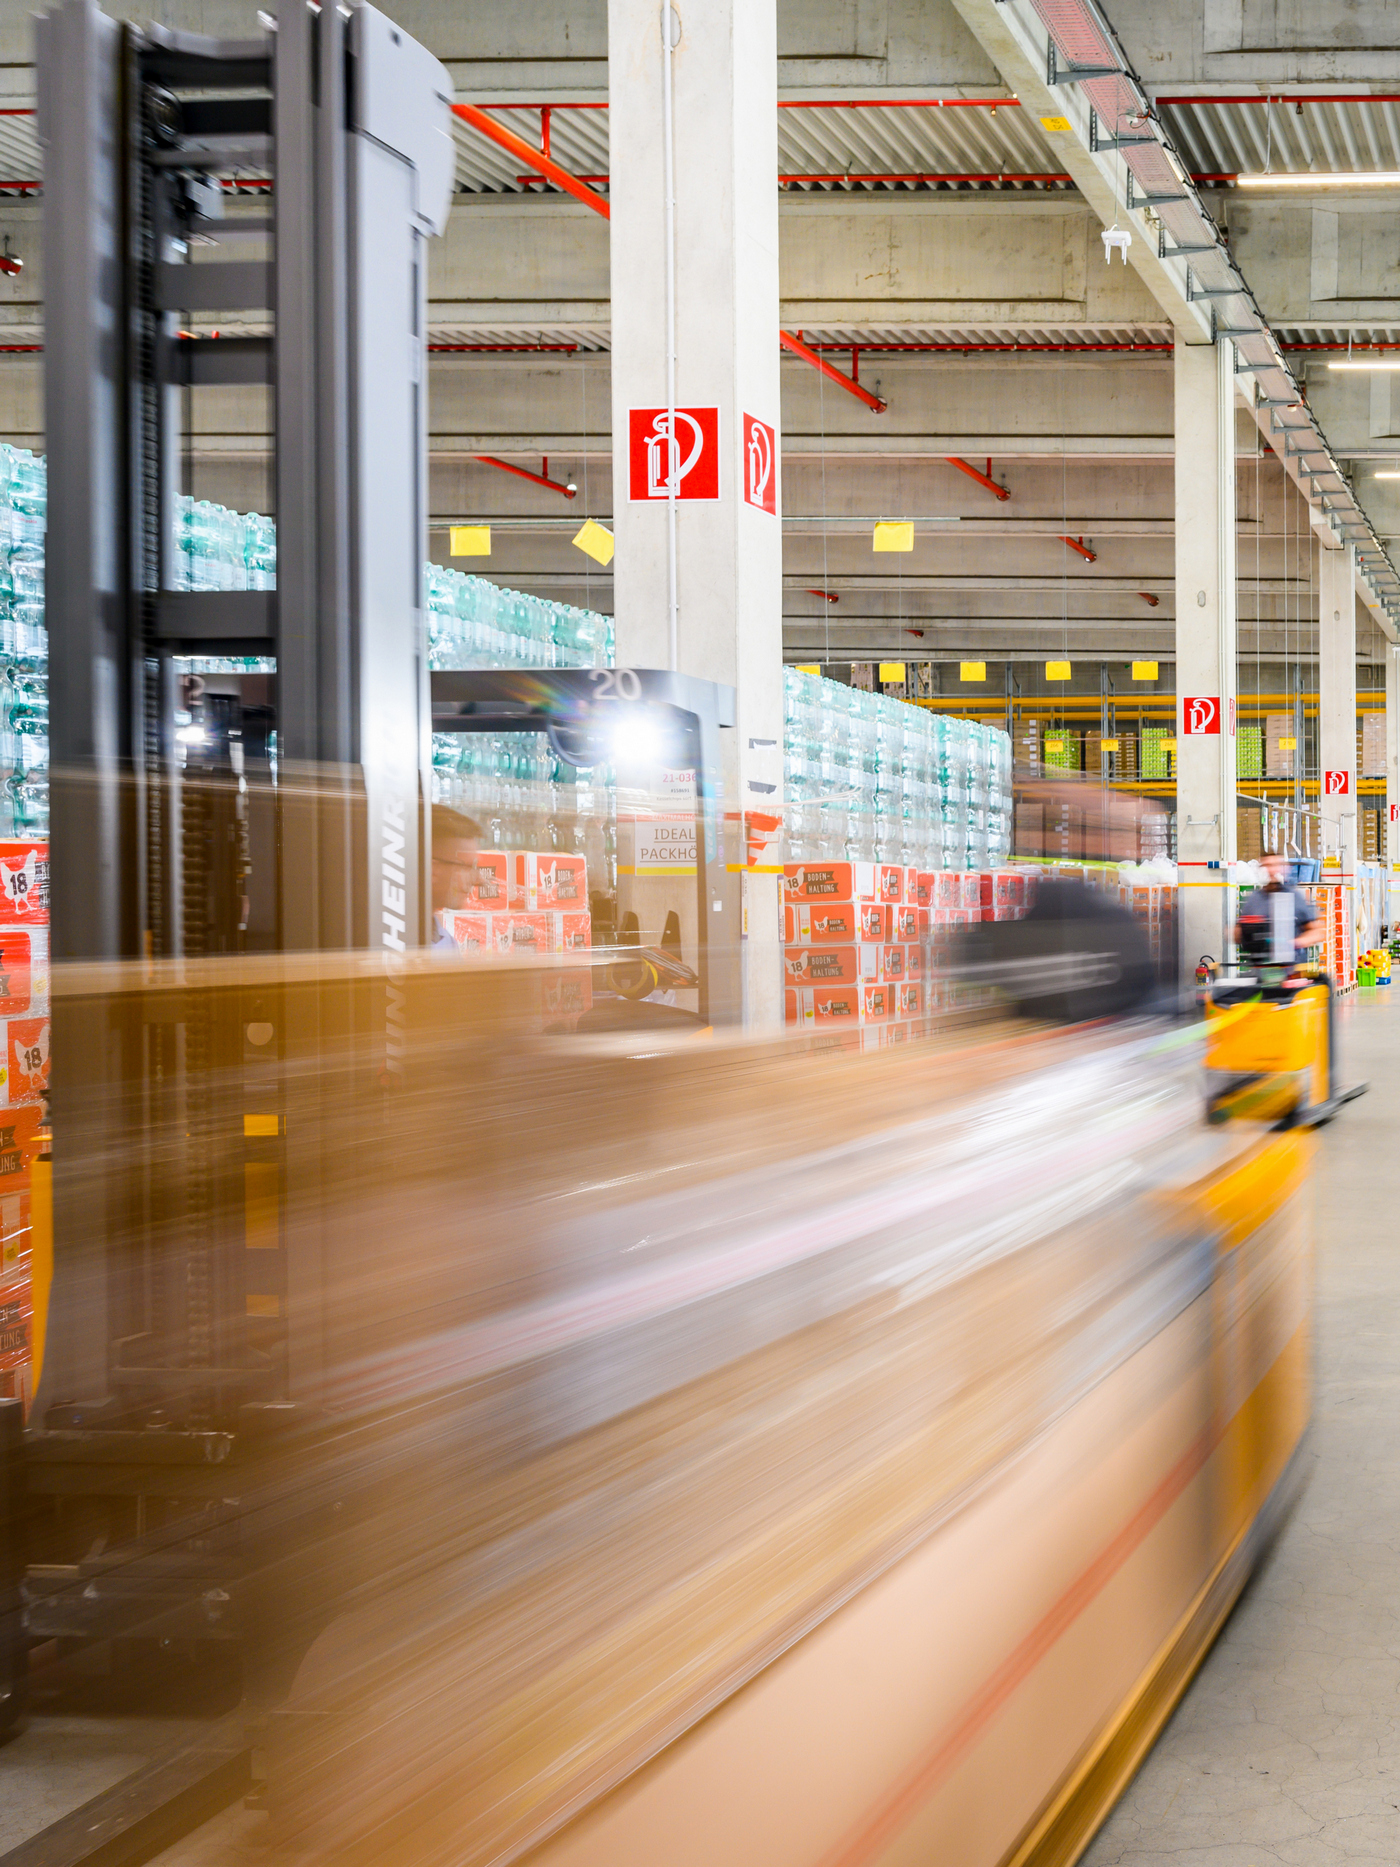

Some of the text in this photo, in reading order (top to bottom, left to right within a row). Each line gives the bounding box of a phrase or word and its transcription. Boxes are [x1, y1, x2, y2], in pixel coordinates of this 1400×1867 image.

[588, 668, 642, 700] 20
[808, 873, 830, 881] BODEN-
[10, 873, 28, 895] 18
[787, 878, 799, 889] 18
[809, 884, 834, 893] HALTUNG
[812, 957, 834, 965] BODEN-
[791, 962, 803, 972] 18
[813, 968, 839, 976] HALTUNG
[24, 1047, 42, 1071] 18
